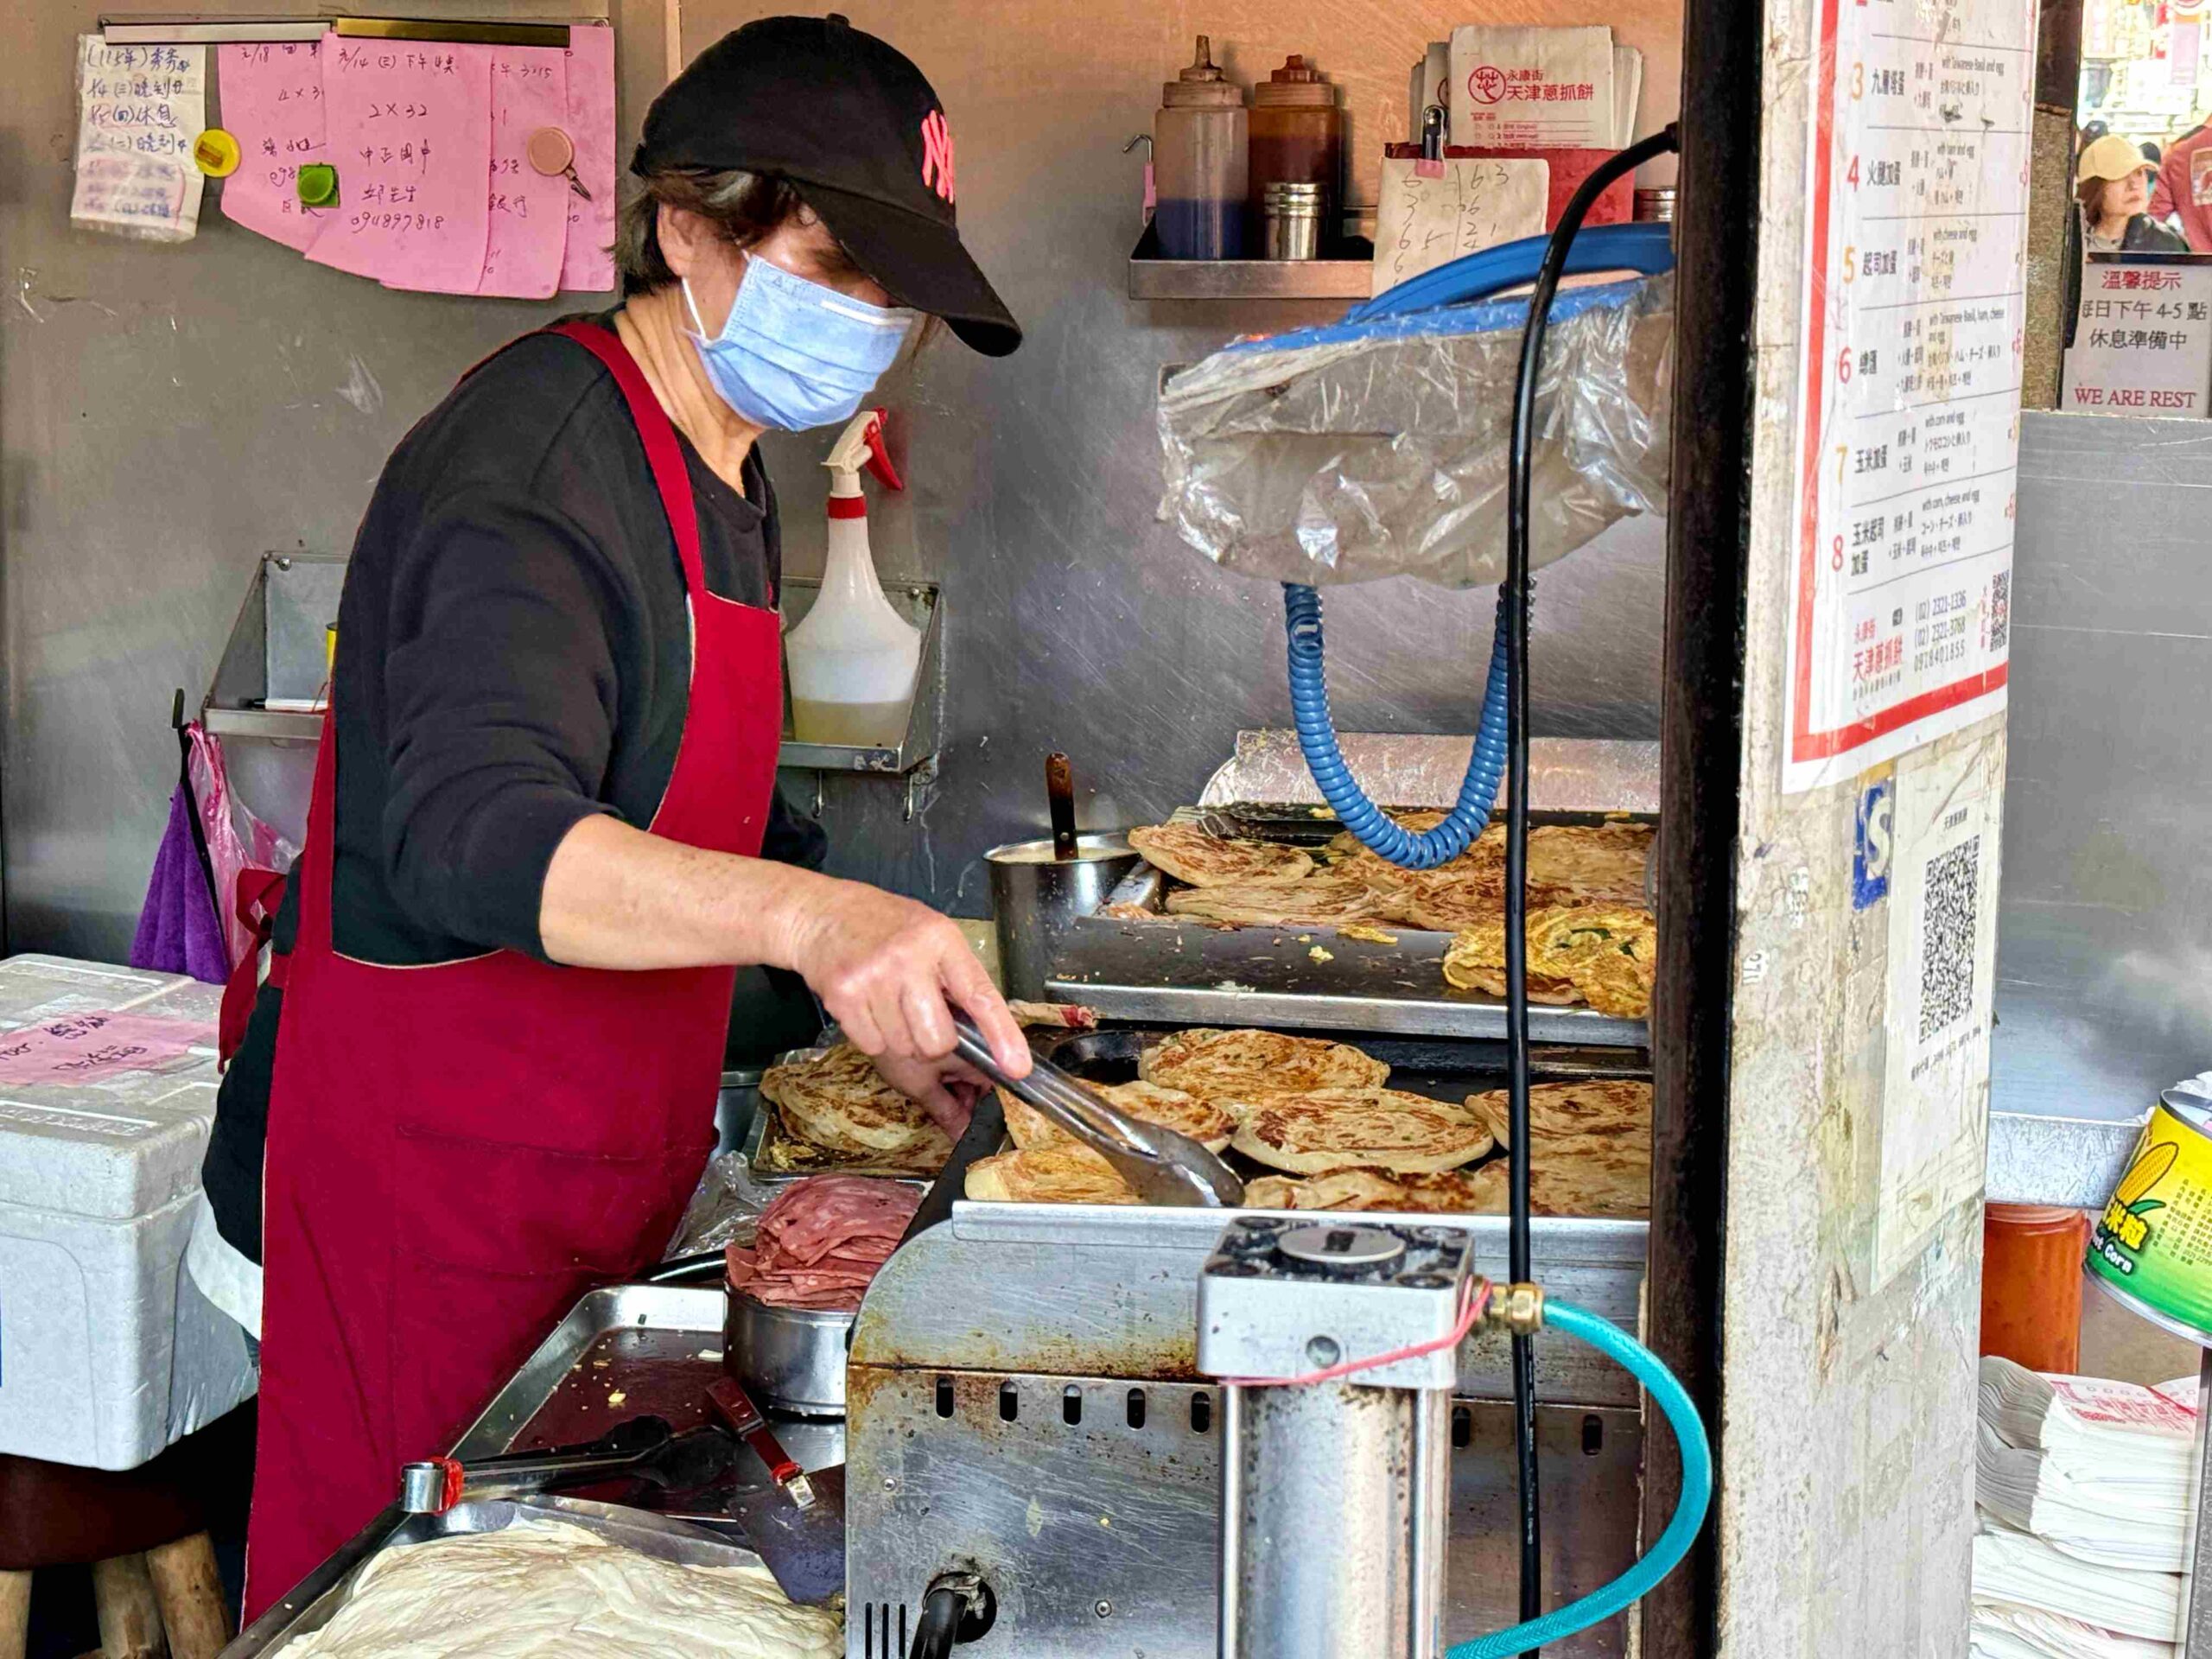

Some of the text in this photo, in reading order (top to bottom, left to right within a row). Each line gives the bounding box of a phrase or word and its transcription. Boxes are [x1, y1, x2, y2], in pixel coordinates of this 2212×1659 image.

[1506, 69, 1544, 82] 永康街
[1852, 61, 1864, 101] 3
[1847, 155, 1859, 193] 4
[1842, 246, 1856, 283] 5
[2101, 270, 2182, 290] 溫馨提示
[2156, 302, 2183, 320] 4-5
[2089, 328, 2187, 350] 休息準備中
[1839, 346, 1852, 385] 6
[2075, 389, 2197, 409] WE ARE REST
[1835, 446, 1848, 484] 7
[1832, 534, 1843, 572] 8
[2103, 1200, 2148, 1251] 米粒
[2104, 1243, 2133, 1273] Corn
